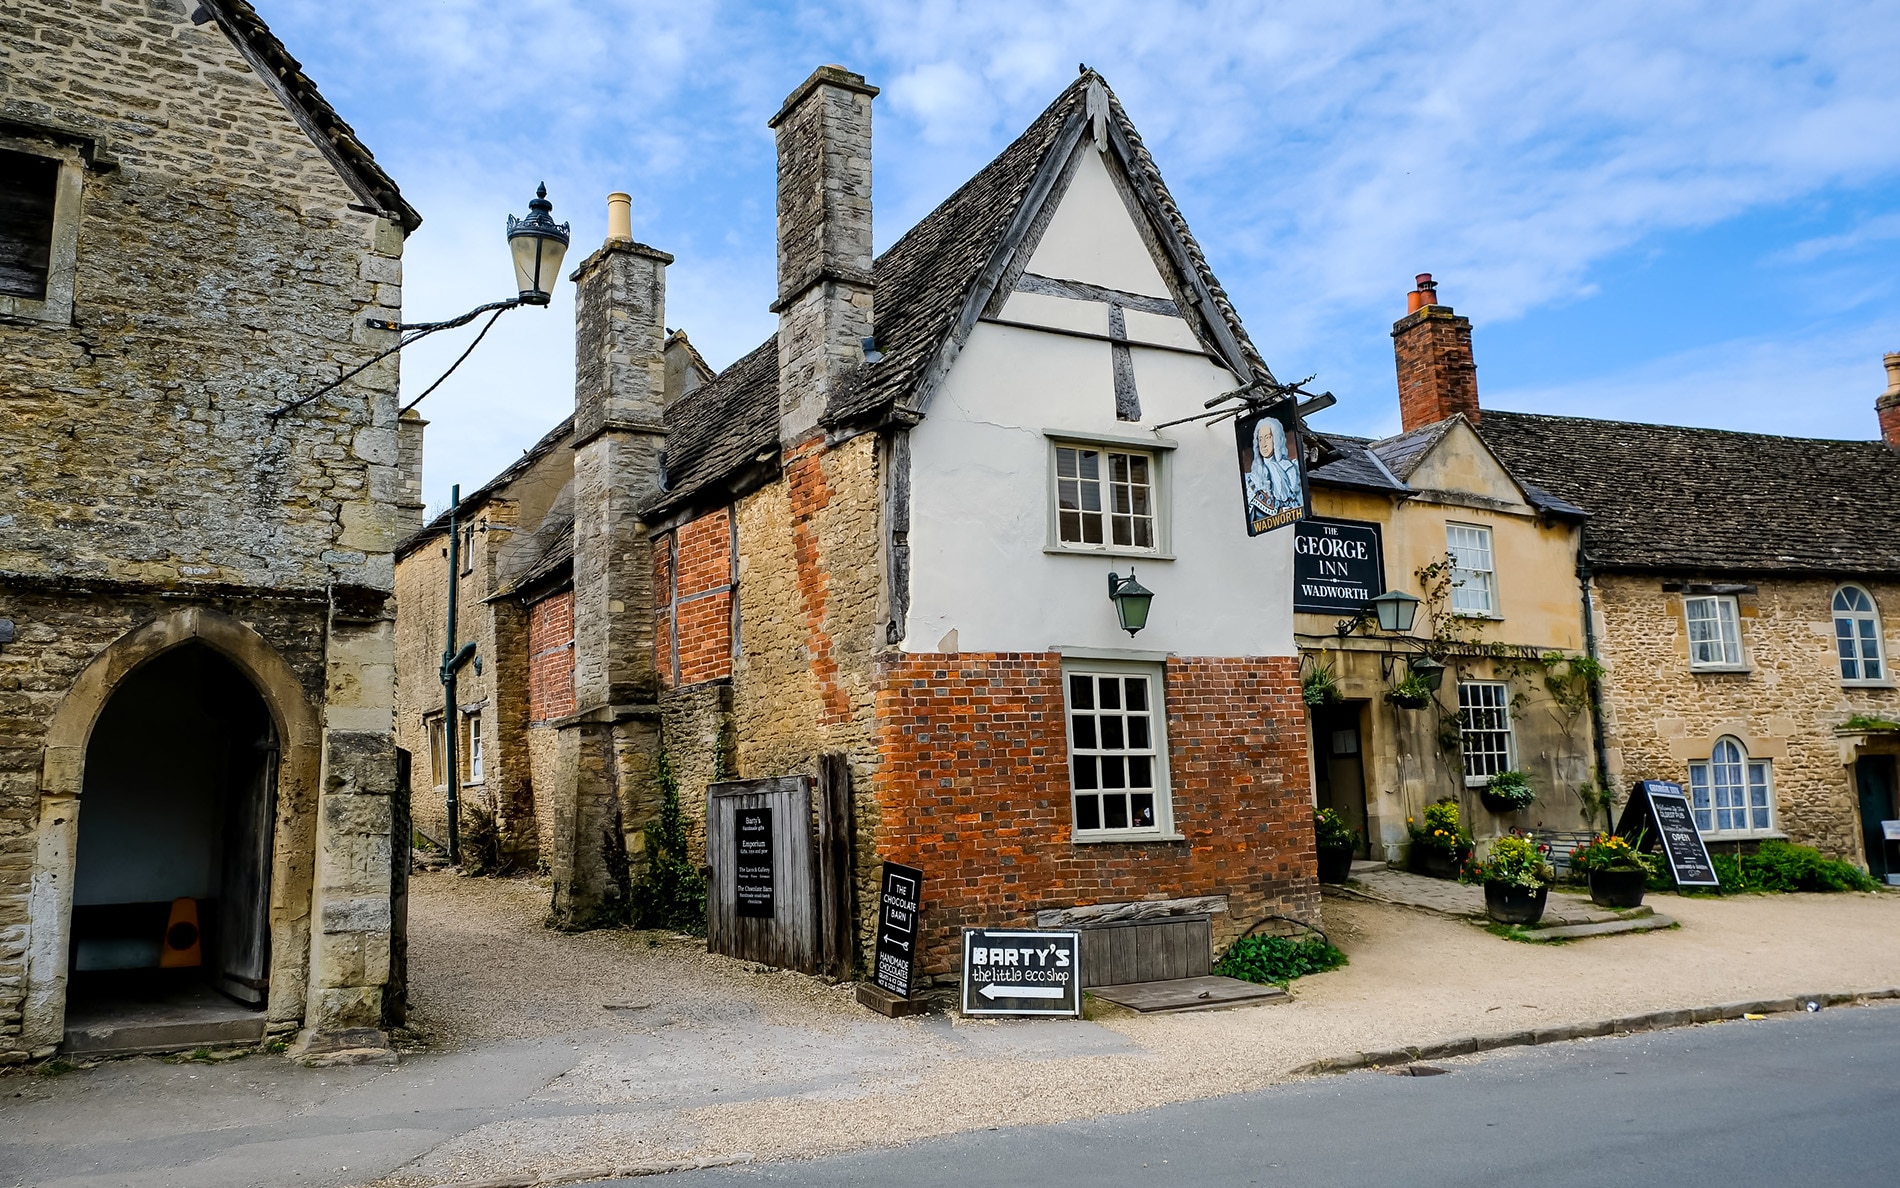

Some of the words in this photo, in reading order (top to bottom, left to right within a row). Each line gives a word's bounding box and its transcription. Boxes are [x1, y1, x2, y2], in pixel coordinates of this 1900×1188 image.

[1253, 508, 1303, 533] WADWORTH
[1323, 527, 1339, 536] THE
[1295, 535, 1368, 560] GEORGE
[1319, 560, 1348, 576] INN
[1301, 584, 1369, 600] WADWORTH
[746, 816, 761, 825] Barty's
[742, 840, 766, 849] Emporium
[1671, 833, 1690, 842] OPEN
[896, 884, 906, 895] THE
[883, 894, 916, 912] CHOCOLATE
[891, 908, 906, 922] BARN
[880, 951, 909, 971] HANDMADE
[972, 943, 1070, 967] BARTY'S
[879, 960, 908, 980] CHOCOLATES
[972, 966, 991, 982] the
[992, 967, 1022, 982] little
[1025, 971, 1045, 982] eco
[1047, 968, 1069, 985] shop
